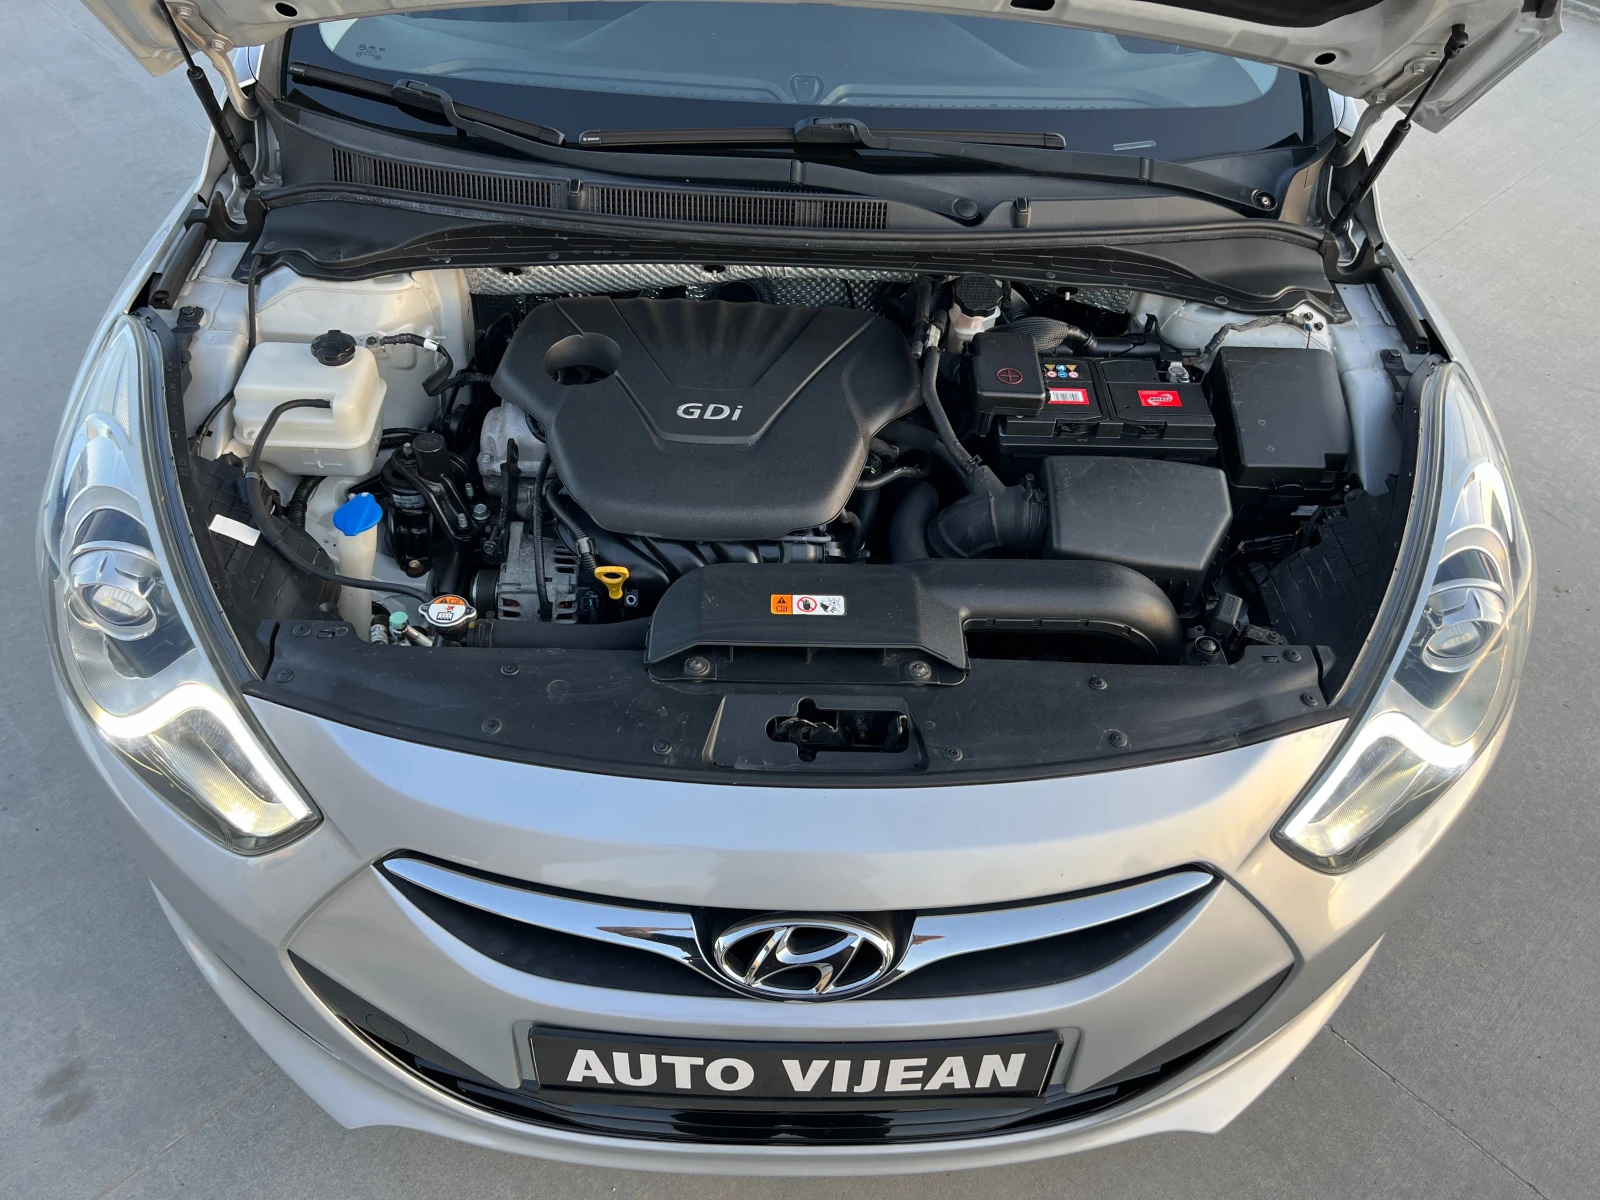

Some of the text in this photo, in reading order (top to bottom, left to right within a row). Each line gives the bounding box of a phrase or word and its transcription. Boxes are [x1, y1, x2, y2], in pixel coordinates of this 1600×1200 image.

[676, 402, 744, 421] GDi
[566, 1049, 1027, 1092] AUTO VIJEAN
